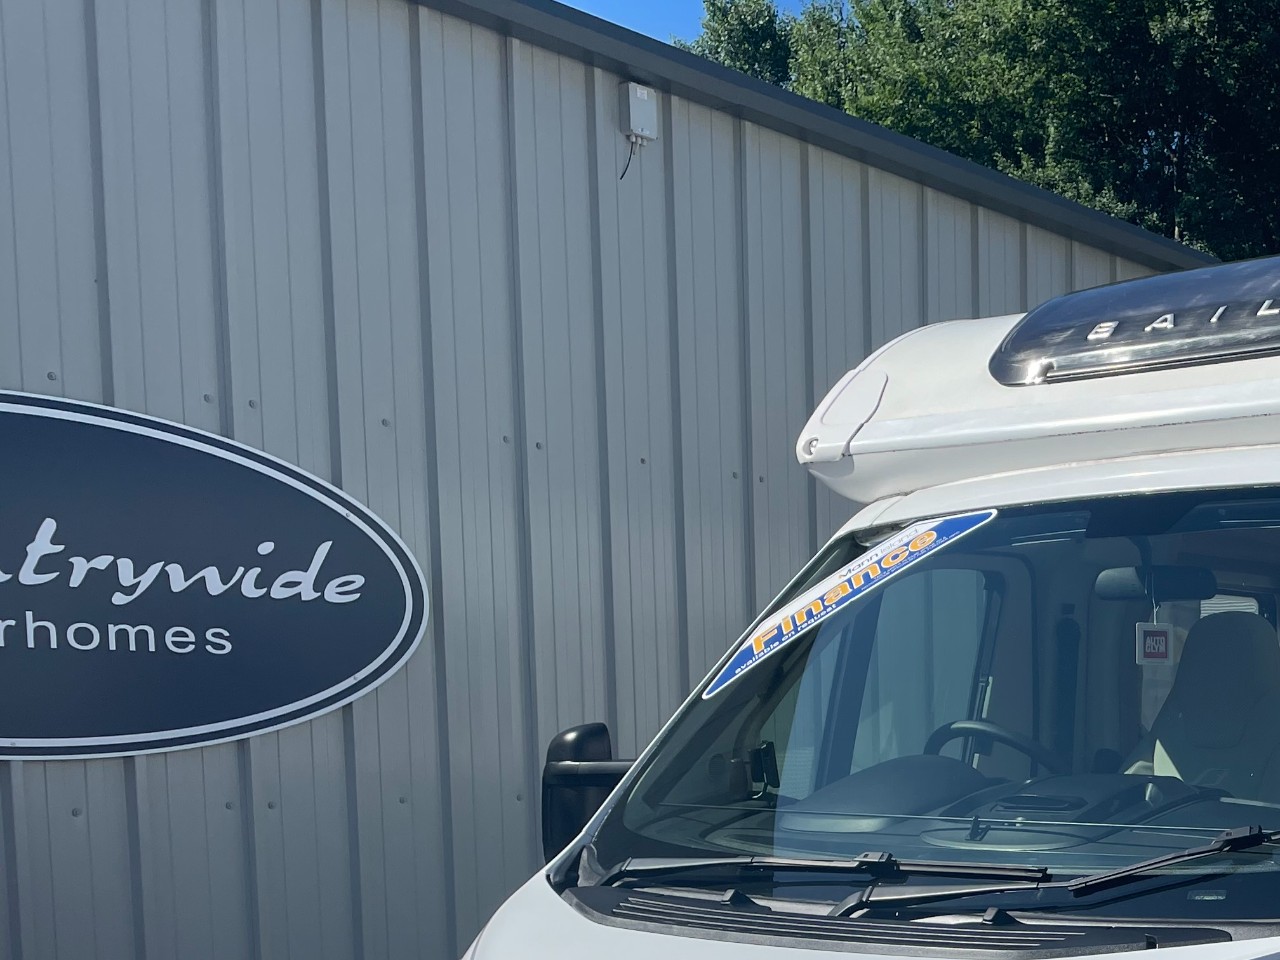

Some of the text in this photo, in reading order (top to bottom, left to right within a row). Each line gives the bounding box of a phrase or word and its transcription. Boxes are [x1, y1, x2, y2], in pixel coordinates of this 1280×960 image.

[0, 517, 366, 605] trywide
[752, 530, 938, 656] Finance
[734, 603, 838, 675] available on request
[1146, 636, 1166, 645] AUTO
